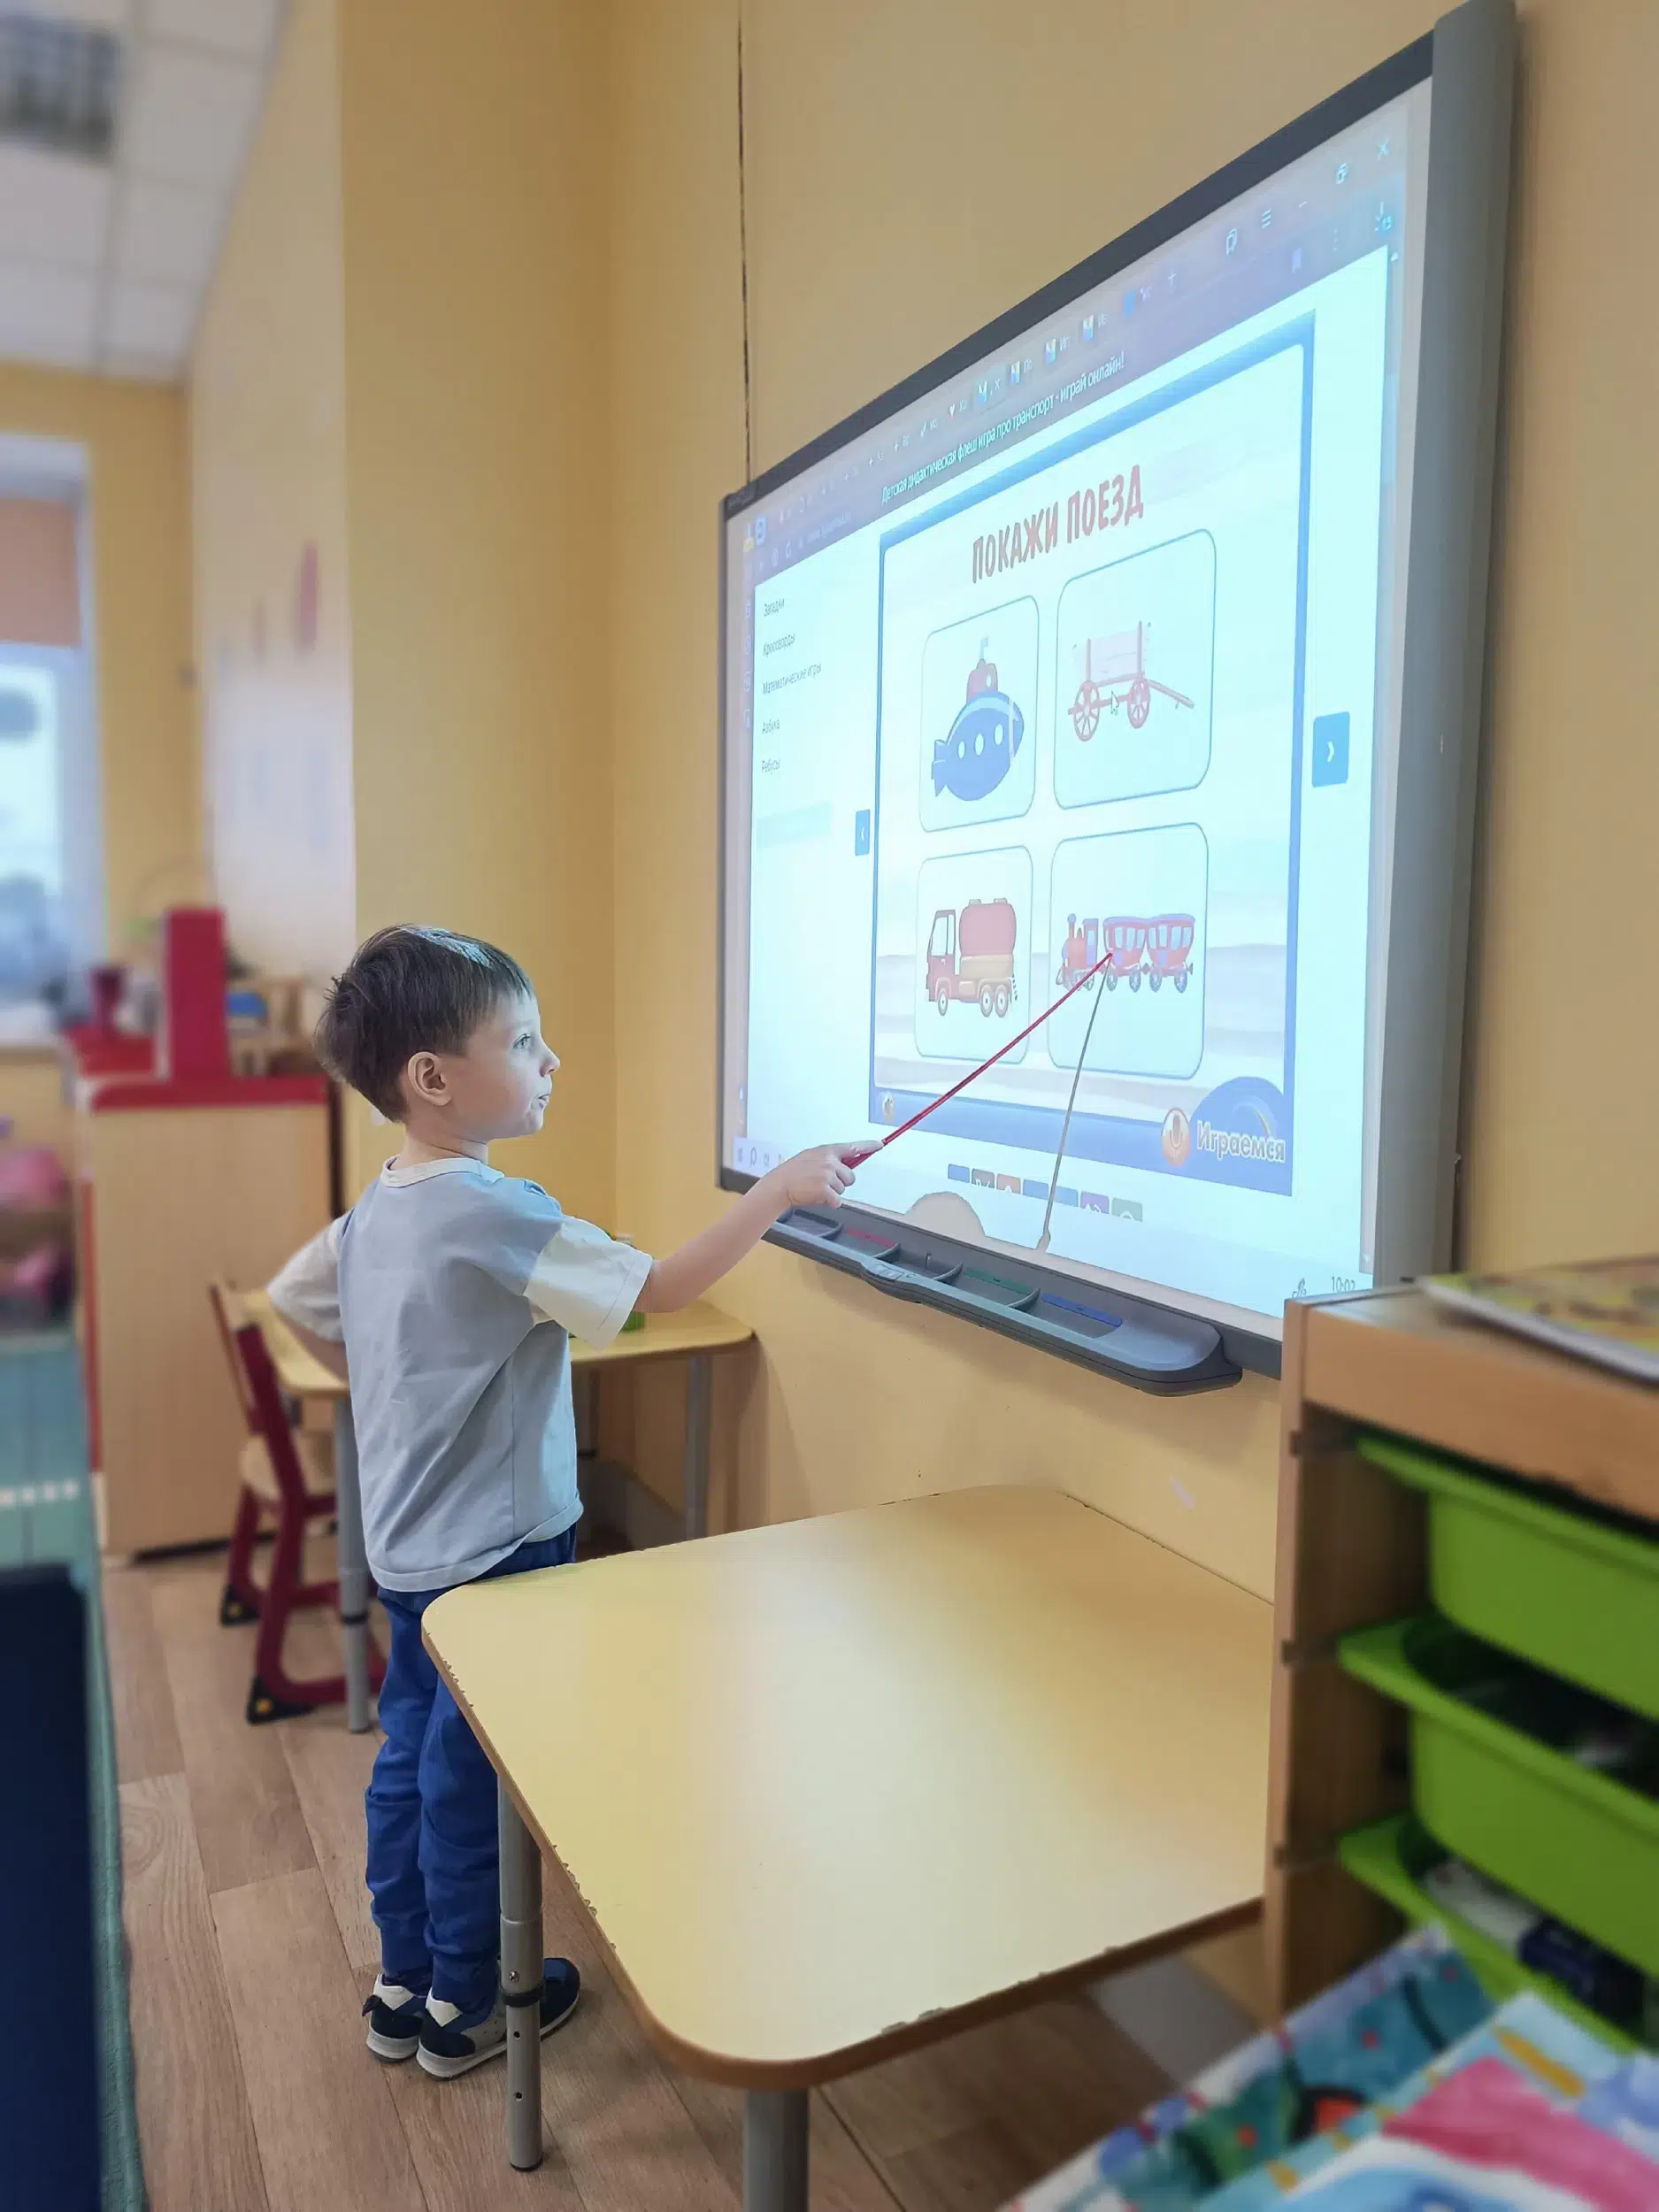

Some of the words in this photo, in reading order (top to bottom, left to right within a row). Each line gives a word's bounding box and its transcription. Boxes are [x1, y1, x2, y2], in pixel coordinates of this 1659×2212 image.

[882, 481, 908, 506] Детская
[907, 449, 956, 491] дидактическая
[957, 437, 978, 463] флеш
[978, 427, 995, 449] игра
[996, 419, 1011, 439] про
[1012, 394, 1055, 432] транспорт
[1060, 373, 1087, 403] играй
[1087, 350, 1125, 387] онлайн!
[972, 501, 1059, 584] ПОКАЖИ
[1066, 465, 1144, 544] ПОЕЗД
[764, 598, 785, 618] Загадки
[763, 668, 807, 695] Математические
[806, 663, 822, 680] игры
[762, 718, 780, 735] Азбука
[762, 758, 780, 775] Ребусы
[1197, 1120, 1286, 1163] Играемся
